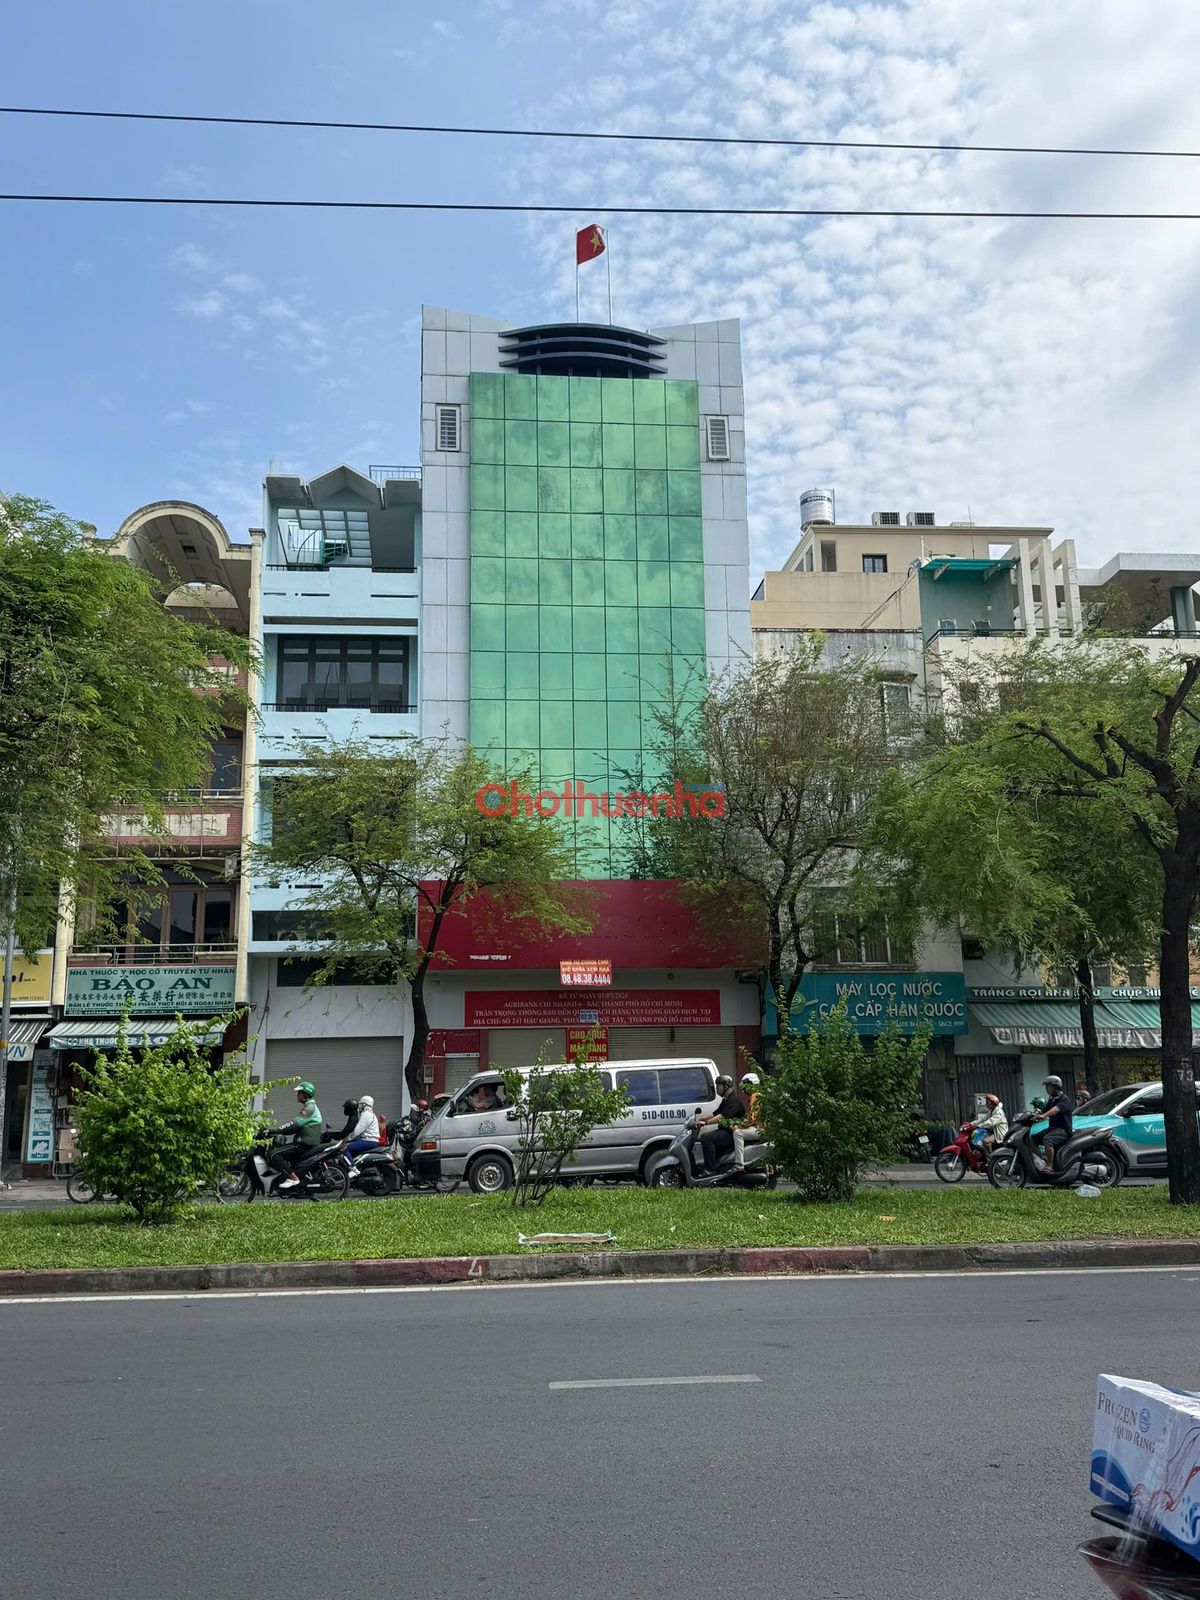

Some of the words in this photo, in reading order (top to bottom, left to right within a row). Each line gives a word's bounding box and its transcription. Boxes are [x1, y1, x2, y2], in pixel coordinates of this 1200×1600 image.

[91, 975, 155, 990] BẢO
[168, 978, 213, 990] AN
[835, 980, 862, 996] MÁY
[870, 983, 897, 1000] LỌC
[903, 979, 943, 996] NƯỚC
[972, 988, 1015, 997] TRÁNG
[1019, 989, 1041, 999] RỌI
[1112, 989, 1142, 999] CHỤP
[625, 999, 639, 1007] PHỐ
[640, 999, 651, 1007] HỒ
[651, 999, 663, 1007] CHÍ
[855, 1000, 883, 1016] CẤP
[889, 1001, 918, 1016] HÀN
[923, 999, 964, 1016] QUỐC
[475, 1009, 494, 1017] TRÂN
[494, 1009, 517, 1017] TRỌNG
[518, 1008, 541, 1016] THÔNG
[542, 1008, 556, 1016] BÁO
[644, 1008, 663, 1016] LÒNG
[502, 1016, 511, 1025] SỐ
[569, 1031, 584, 1040] CHO
[1177, 1069, 1194, 1082] 73
[641, 1109, 687, 1120] 51D-010.90
[1134, 1431, 1156, 1454] RING
